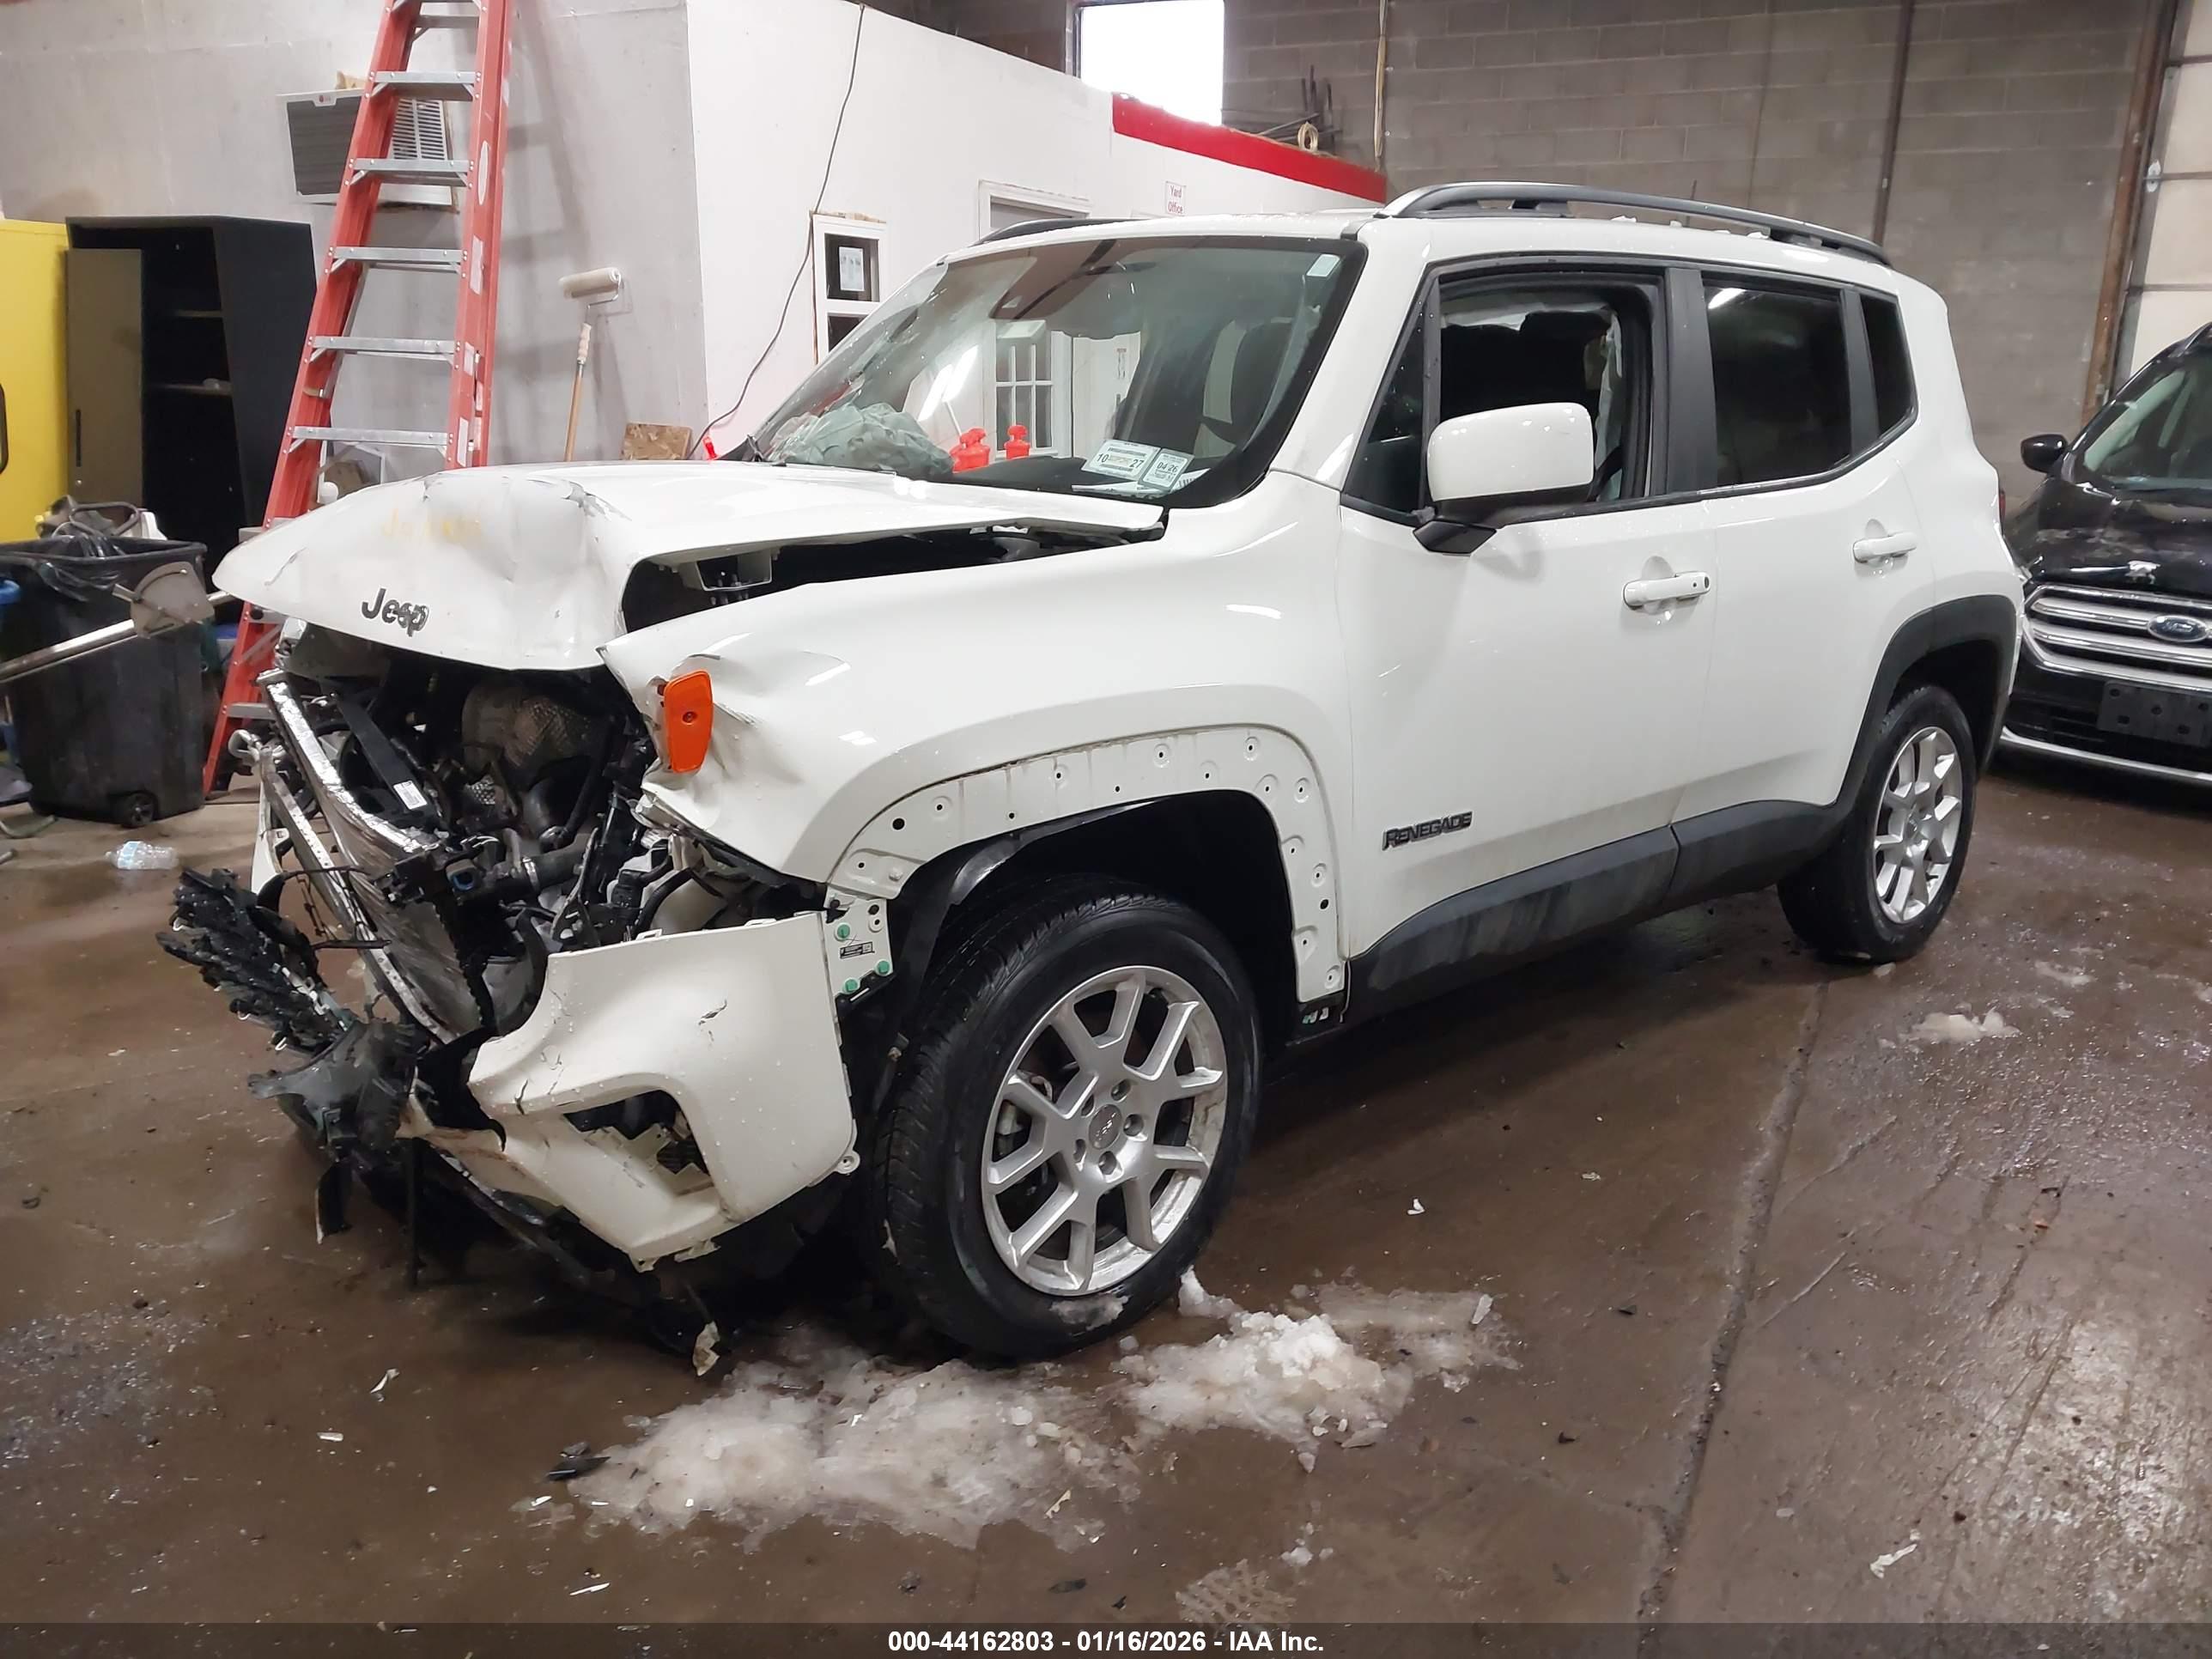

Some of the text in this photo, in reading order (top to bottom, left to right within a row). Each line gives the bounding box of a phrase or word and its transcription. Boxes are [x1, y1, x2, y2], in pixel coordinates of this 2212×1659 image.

[1170, 185, 1182, 198] Yard
[1168, 201, 1183, 214] Office
[1097, 453, 1109, 463] 10
[1129, 459, 1145, 469] 27
[1157, 461, 1179, 473] 04 26
[361, 587, 429, 638] Jeep
[1381, 811, 1473, 851] RENEGADE
